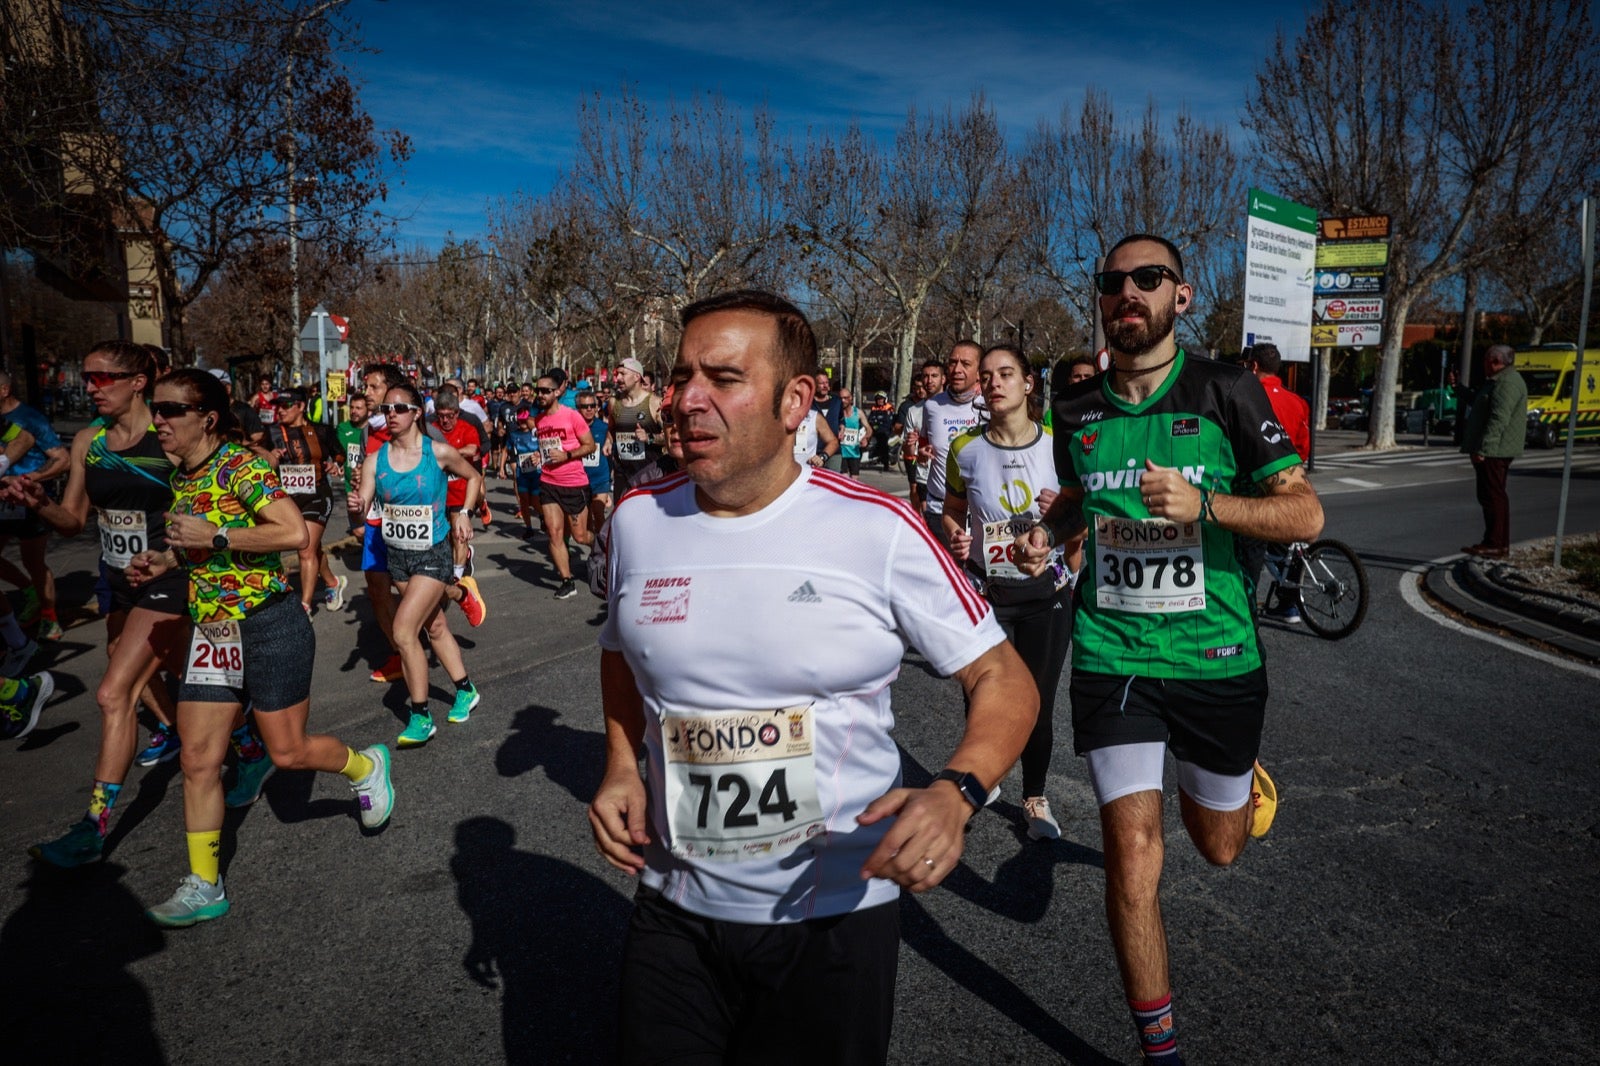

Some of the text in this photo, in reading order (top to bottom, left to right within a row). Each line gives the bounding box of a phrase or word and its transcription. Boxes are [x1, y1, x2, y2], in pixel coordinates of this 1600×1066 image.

[1347, 217, 1388, 229] ESTANCO
[620, 442, 640, 453] 296
[283, 476, 314, 488] 2202
[385, 522, 429, 540] 3062
[1115, 525, 1178, 541] FONDO
[1103, 554, 1196, 589] 3078
[686, 723, 780, 751] FONDO
[688, 767, 798, 830] 724
